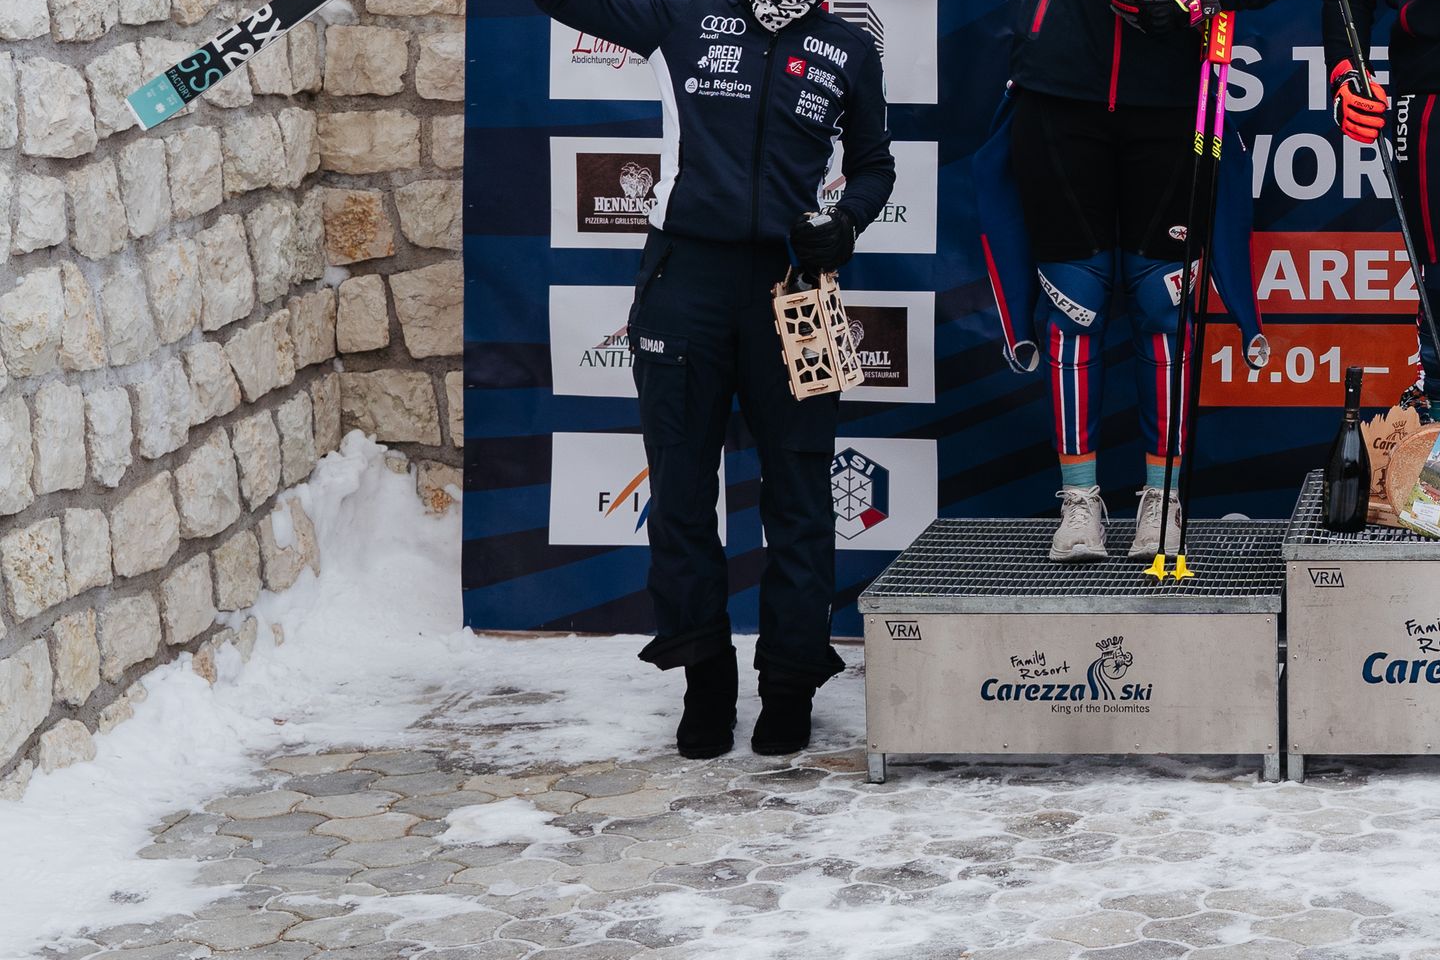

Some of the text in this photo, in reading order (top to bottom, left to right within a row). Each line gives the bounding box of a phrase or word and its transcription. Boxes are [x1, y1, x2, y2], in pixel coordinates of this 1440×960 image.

[1215, 11, 1228, 59] LEKI
[571, 55, 620, 65] Abdichtungen
[708, 45, 743, 60] GREEN
[803, 36, 848, 69] COLMAR
[709, 58, 739, 74] WEEZ
[808, 66, 837, 82] CAISSE
[168, 69, 193, 101] FACTORY
[699, 79, 752, 93] La Région
[800, 90, 830, 108] SAVOIE
[795, 106, 825, 124] BLANC
[585, 217, 648, 225] PIZZERIA GRILLSTUBE
[1038, 272, 1079, 315] CRAFT
[599, 492, 639, 512] FI
[1309, 569, 1344, 587] VRM
[887, 622, 920, 639] VRM
[1010, 650, 1046, 668] Family
[1020, 663, 1071, 680] Resort
[980, 678, 1153, 702] Carezza Ski
[1051, 703, 1151, 715] King of the Dolomites
